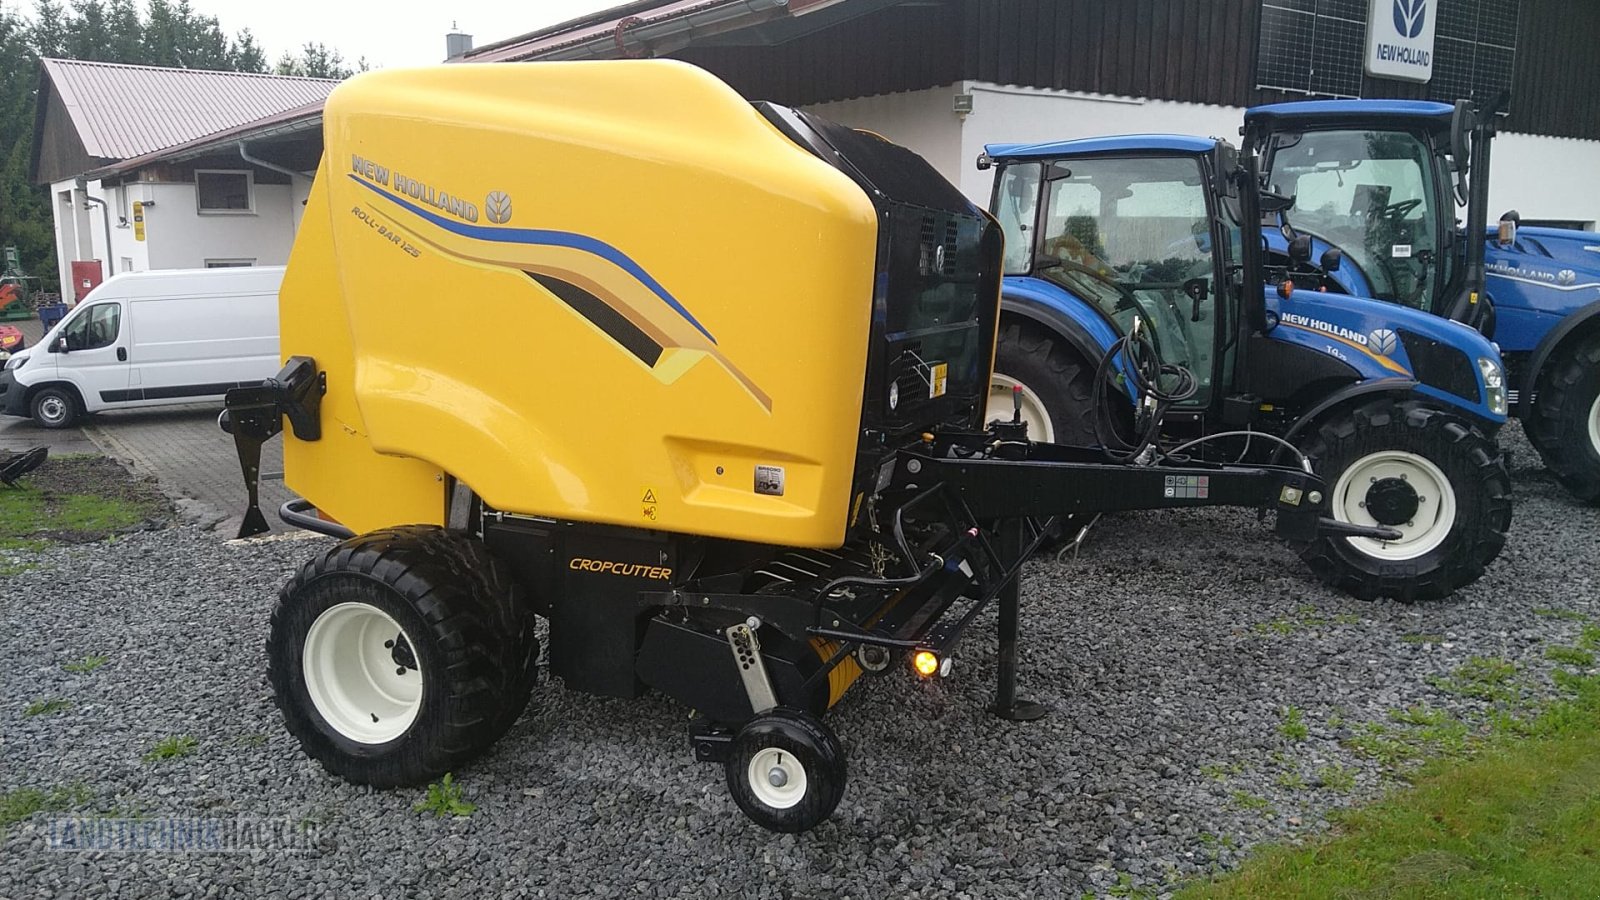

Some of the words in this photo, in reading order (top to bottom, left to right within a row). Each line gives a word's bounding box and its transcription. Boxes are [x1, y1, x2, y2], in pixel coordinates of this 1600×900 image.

[1377, 43, 1397, 61] NEW
[1396, 46, 1430, 67] HOLLAND
[351, 153, 390, 187] NEW
[393, 171, 479, 223] HOLLAND
[351, 206, 401, 246] ROLL-BAR
[400, 240, 422, 258] 125
[1499, 265, 1556, 282] HOLLAND
[1281, 312, 1310, 326] NEW
[1310, 319, 1368, 346] HOLLAND
[569, 557, 673, 581] CROPCUTTER
